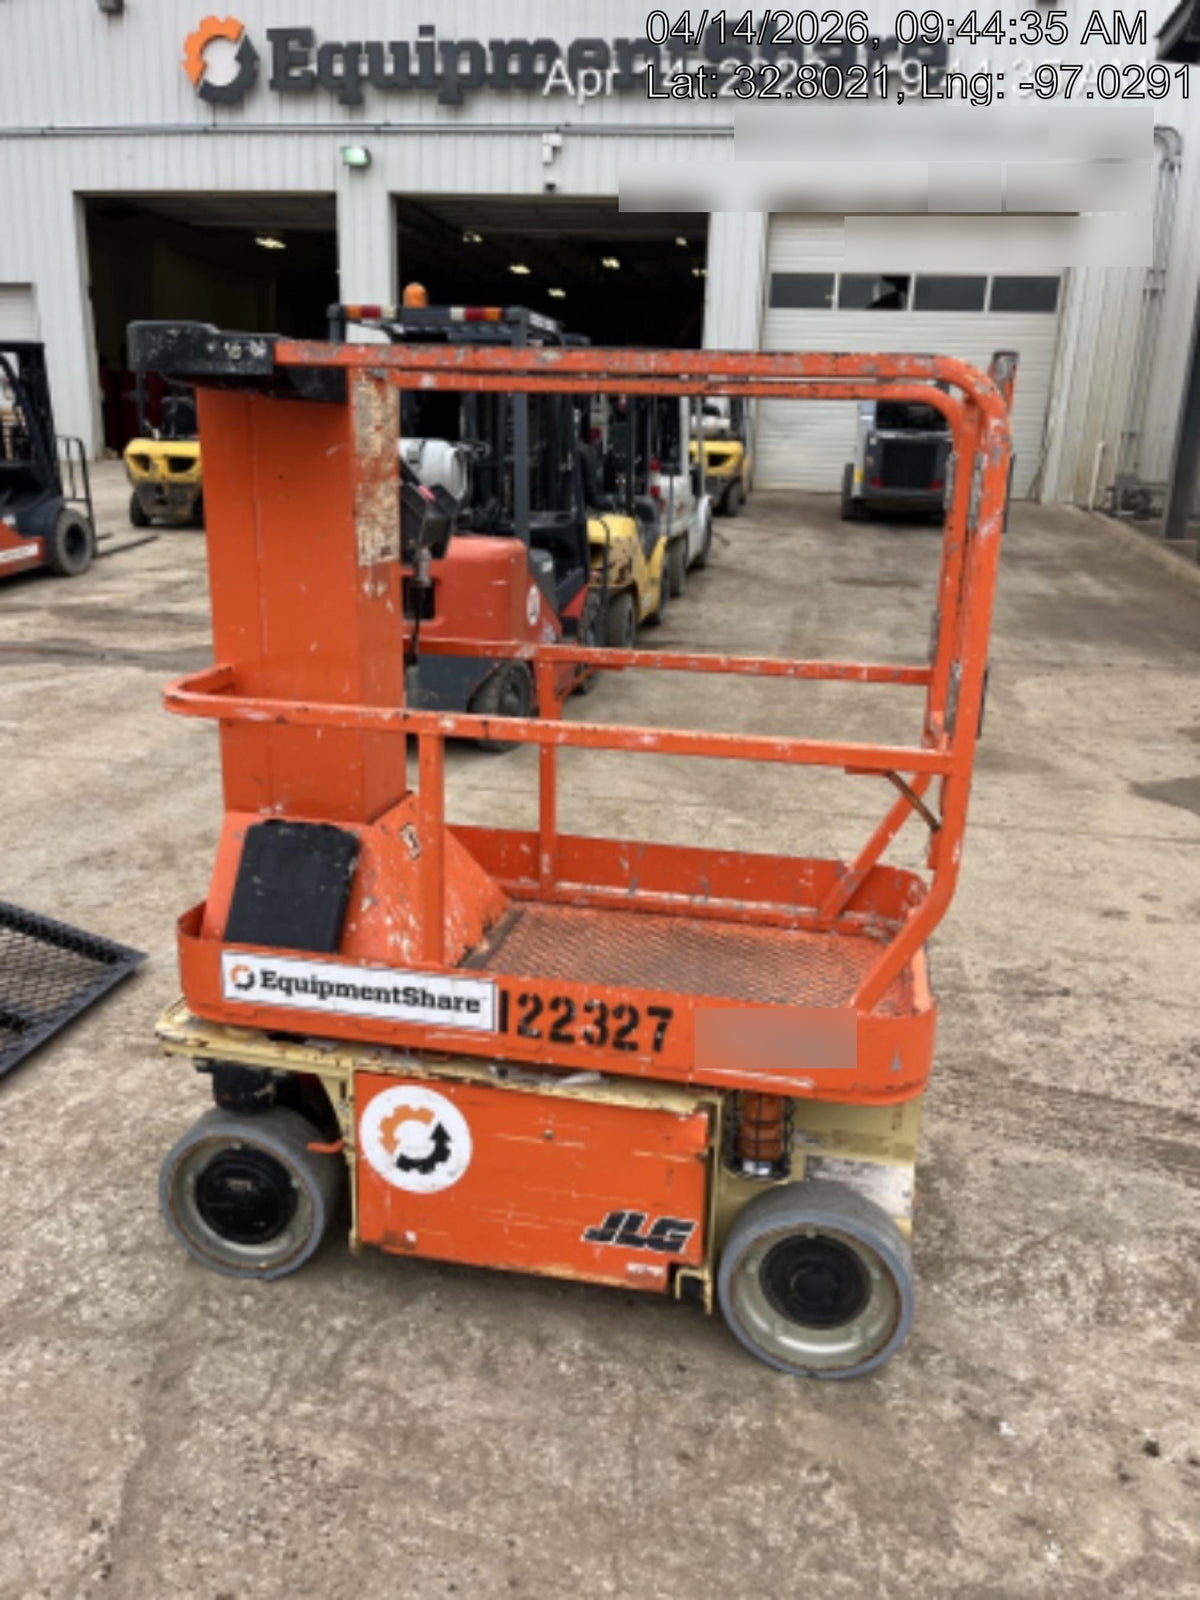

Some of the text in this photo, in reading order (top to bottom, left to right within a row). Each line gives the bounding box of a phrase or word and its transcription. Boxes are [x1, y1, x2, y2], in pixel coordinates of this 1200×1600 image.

[265, 20, 949, 104] EquipmentShare
[260, 969, 481, 1014] EquipmentShare
[499, 989, 674, 1053] 122327
[580, 1208, 698, 1254] JLG
